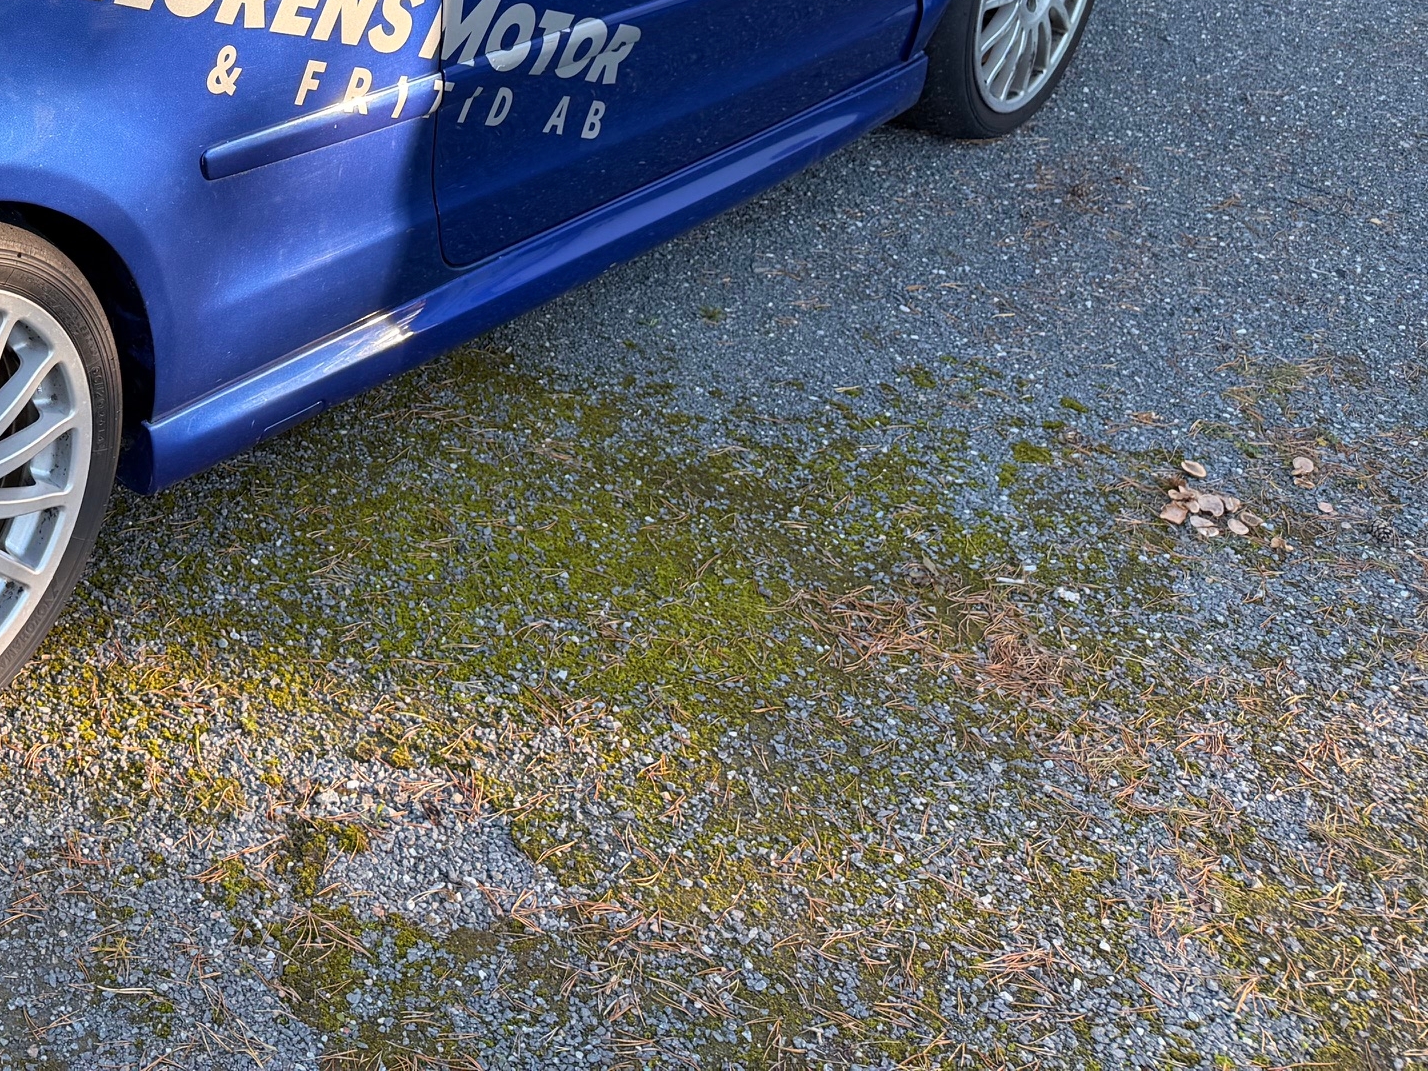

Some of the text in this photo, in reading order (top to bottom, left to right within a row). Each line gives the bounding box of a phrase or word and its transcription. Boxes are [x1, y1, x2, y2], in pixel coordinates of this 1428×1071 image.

[206, 44, 606, 140] & FRITID AB
